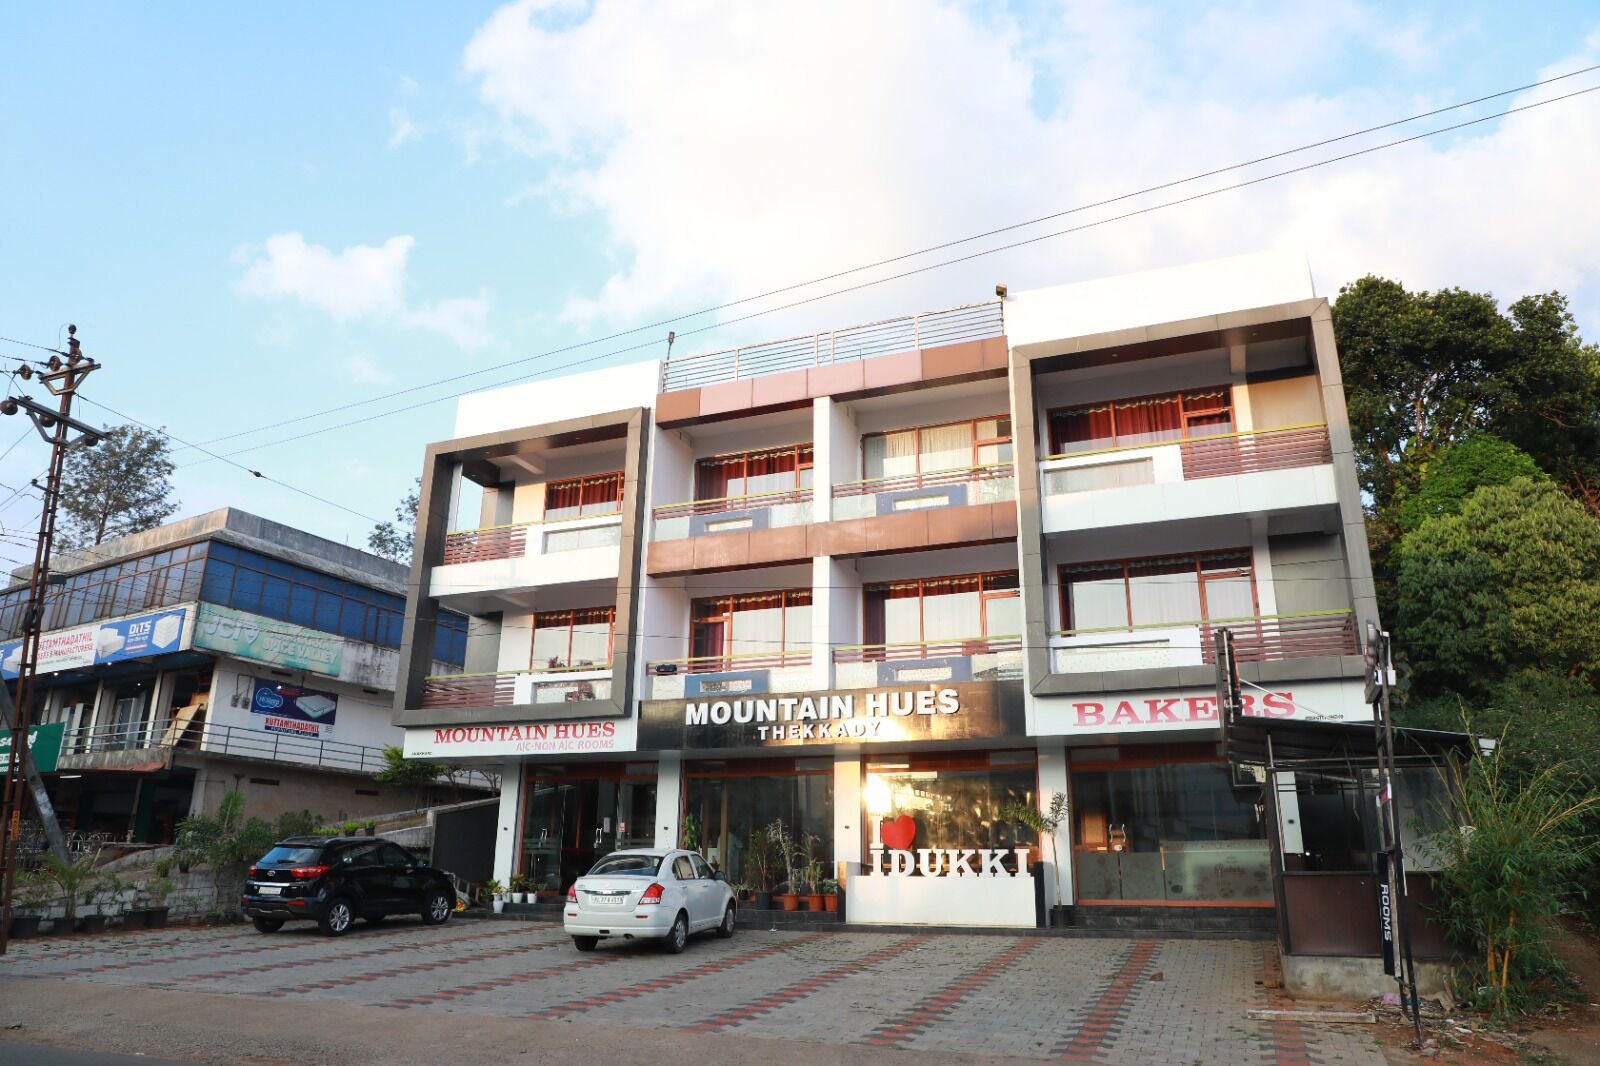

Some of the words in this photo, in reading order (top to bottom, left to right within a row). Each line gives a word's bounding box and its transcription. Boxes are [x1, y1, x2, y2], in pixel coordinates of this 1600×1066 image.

[686, 695, 854, 726] MOUNTAIN
[866, 689, 960, 717] HUES
[1072, 692, 1296, 727] BAKERS
[434, 723, 548, 744] MOUNTAIN
[555, 721, 615, 740] HUES
[577, 739, 615, 750] ROOMS
[757, 721, 881, 741] THEKKADY
[870, 849, 1032, 877] IDUKKI
[1380, 884, 1393, 941] ROOMS
